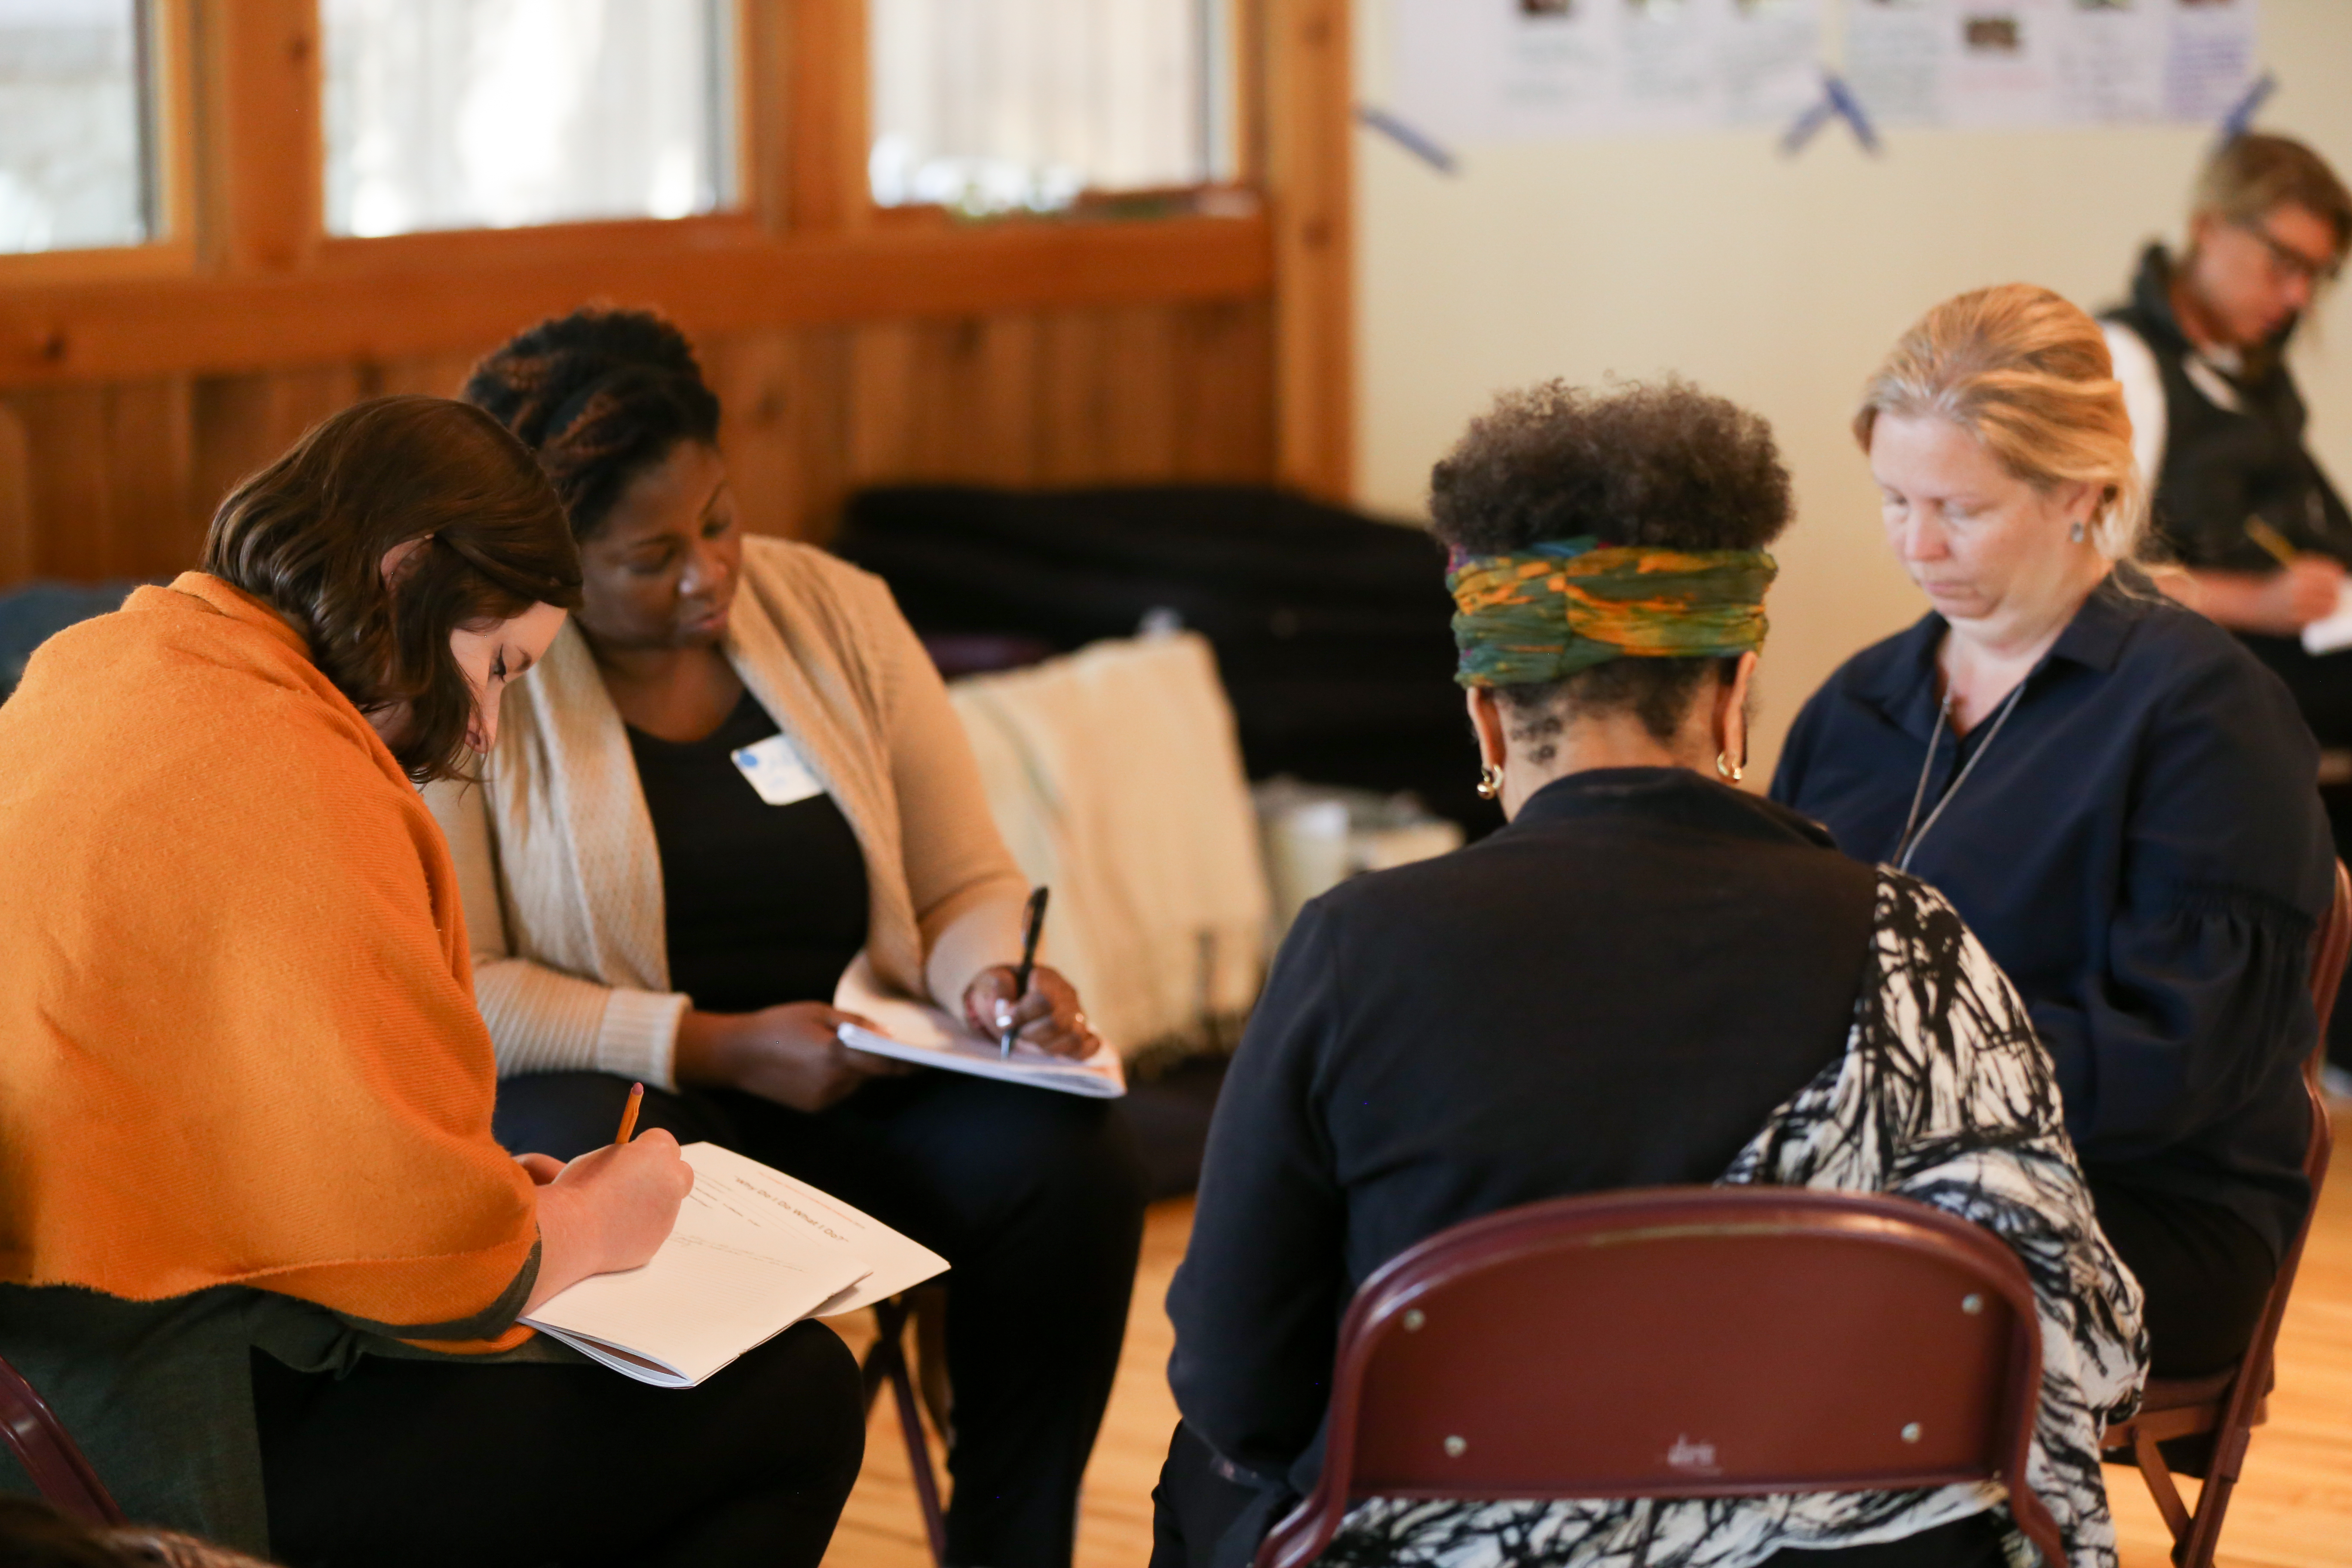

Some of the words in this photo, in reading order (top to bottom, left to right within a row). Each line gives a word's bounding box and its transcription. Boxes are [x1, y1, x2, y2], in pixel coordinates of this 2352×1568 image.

[757, 1189, 771, 1198] Do
[777, 1200, 791, 1210] Do
[793, 1209, 818, 1226] What
